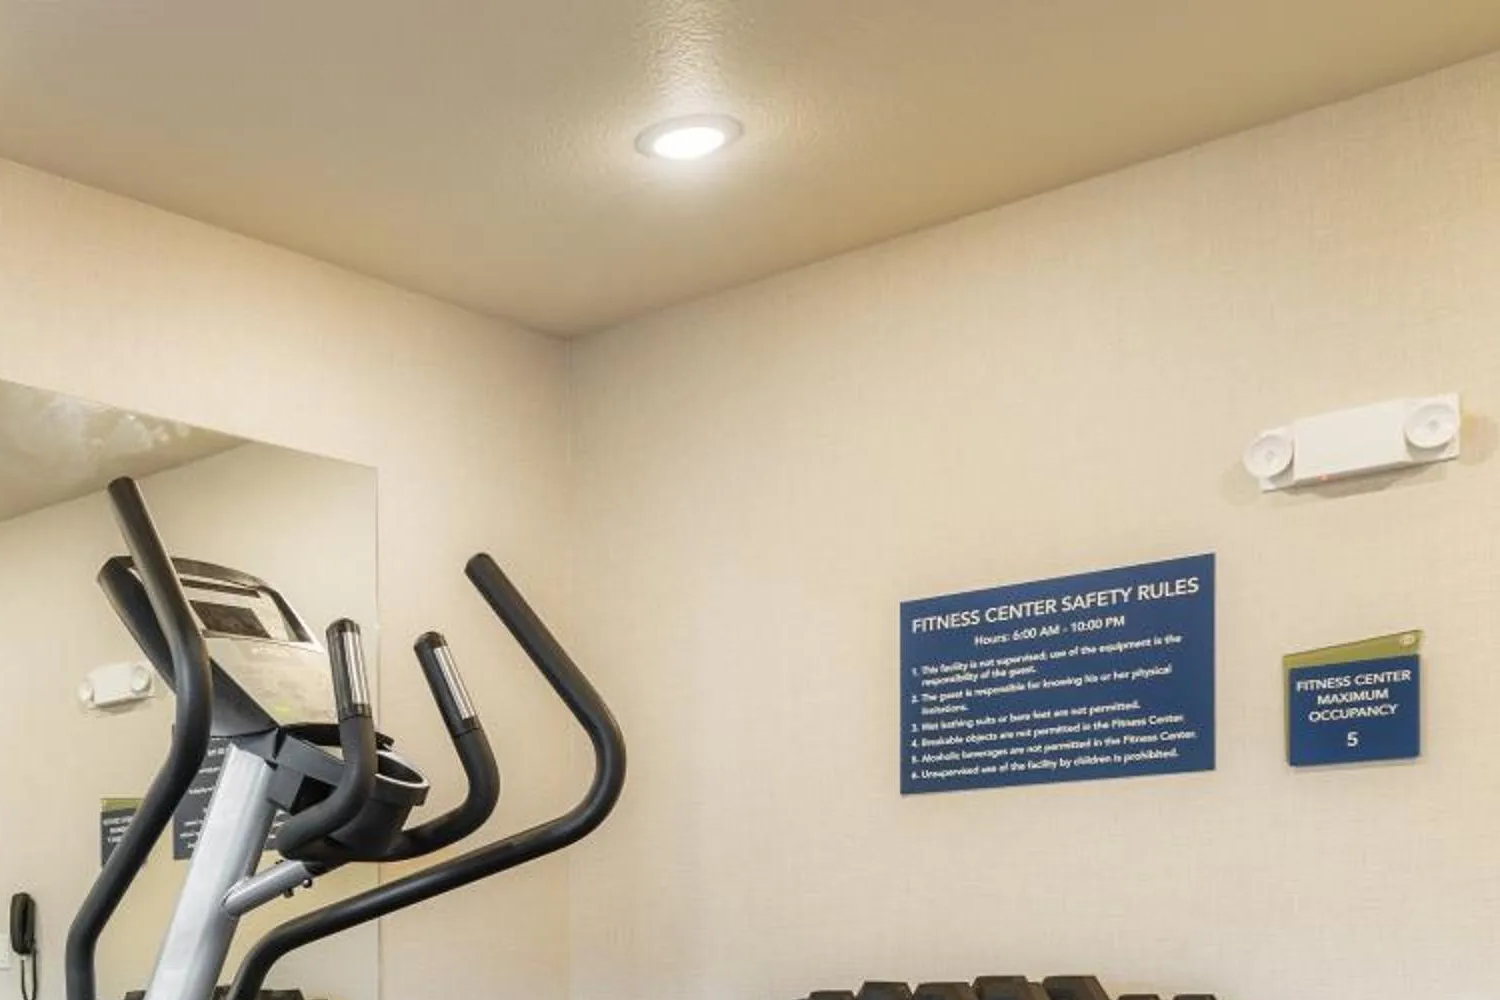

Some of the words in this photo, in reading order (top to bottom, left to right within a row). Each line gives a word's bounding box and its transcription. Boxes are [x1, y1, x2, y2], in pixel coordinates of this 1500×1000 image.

[912, 608, 981, 634] FITNESS
[985, 599, 1057, 624] CENTER
[1061, 587, 1133, 612] SAFETY
[1137, 577, 1200, 601] RULES
[974, 632, 1008, 646] Hours:
[1012, 628, 1037, 641] 6:00
[1040, 624, 1060, 637] AM
[1071, 619, 1102, 634] 10:00
[1105, 616, 1125, 629] PM
[969, 660, 977, 669] is
[980, 660, 995, 668] not
[1050, 651, 1067, 659] use
[1068, 646, 1079, 657] of
[1080, 645, 1097, 655] the
[1098, 638, 1152, 653] equipment
[1153, 637, 1162, 646] is
[1164, 633, 1183, 645] the
[921, 693, 937, 702] The
[940, 691, 962, 703] guest
[965, 688, 972, 697] is
[974, 682, 1025, 697] responsible
[1027, 680, 1040, 689] for
[1042, 677, 1083, 689] knowing
[1100, 673, 1112, 681] or
[1113, 671, 1130, 680] her
[1131, 663, 1173, 680] physical
[980, 669, 991, 679] of
[992, 669, 1007, 678] the
[1296, 675, 1351, 692] FITNESS
[1353, 669, 1412, 686] CENTER
[1317, 688, 1389, 705] MAXIMUM
[998, 715, 1008, 723] or
[1053, 709, 1069, 718] are
[1070, 707, 1086, 716] not
[1308, 703, 1399, 723] OCCUPANCY
[965, 733, 998, 744] objects
[1000, 732, 1014, 740] are
[1015, 729, 1031, 738] not
[1033, 723, 1081, 738] permitted
[1082, 721, 1091, 730] in
[1093, 720, 1110, 729] the
[1111, 717, 1147, 728] Fitness
[1347, 731, 1359, 747] 5
[962, 748, 1009, 759] beverages
[1010, 747, 1025, 755] are
[1026, 745, 1042, 753] not
[1043, 739, 1091, 754] permitted
[1093, 738, 1102, 747] in
[1104, 737, 1121, 746] the
[1123, 733, 1158, 743] Fitness
[921, 765, 979, 780] Unsupervised
[981, 765, 997, 773] use
[999, 762, 1009, 772] of
[1010, 761, 1026, 770] the
[1027, 759, 1057, 771] facility
[1059, 757, 1072, 768] by
[1073, 754, 1112, 766] children
[1113, 753, 1122, 762] is
[1123, 748, 1180, 764] prohibited.
